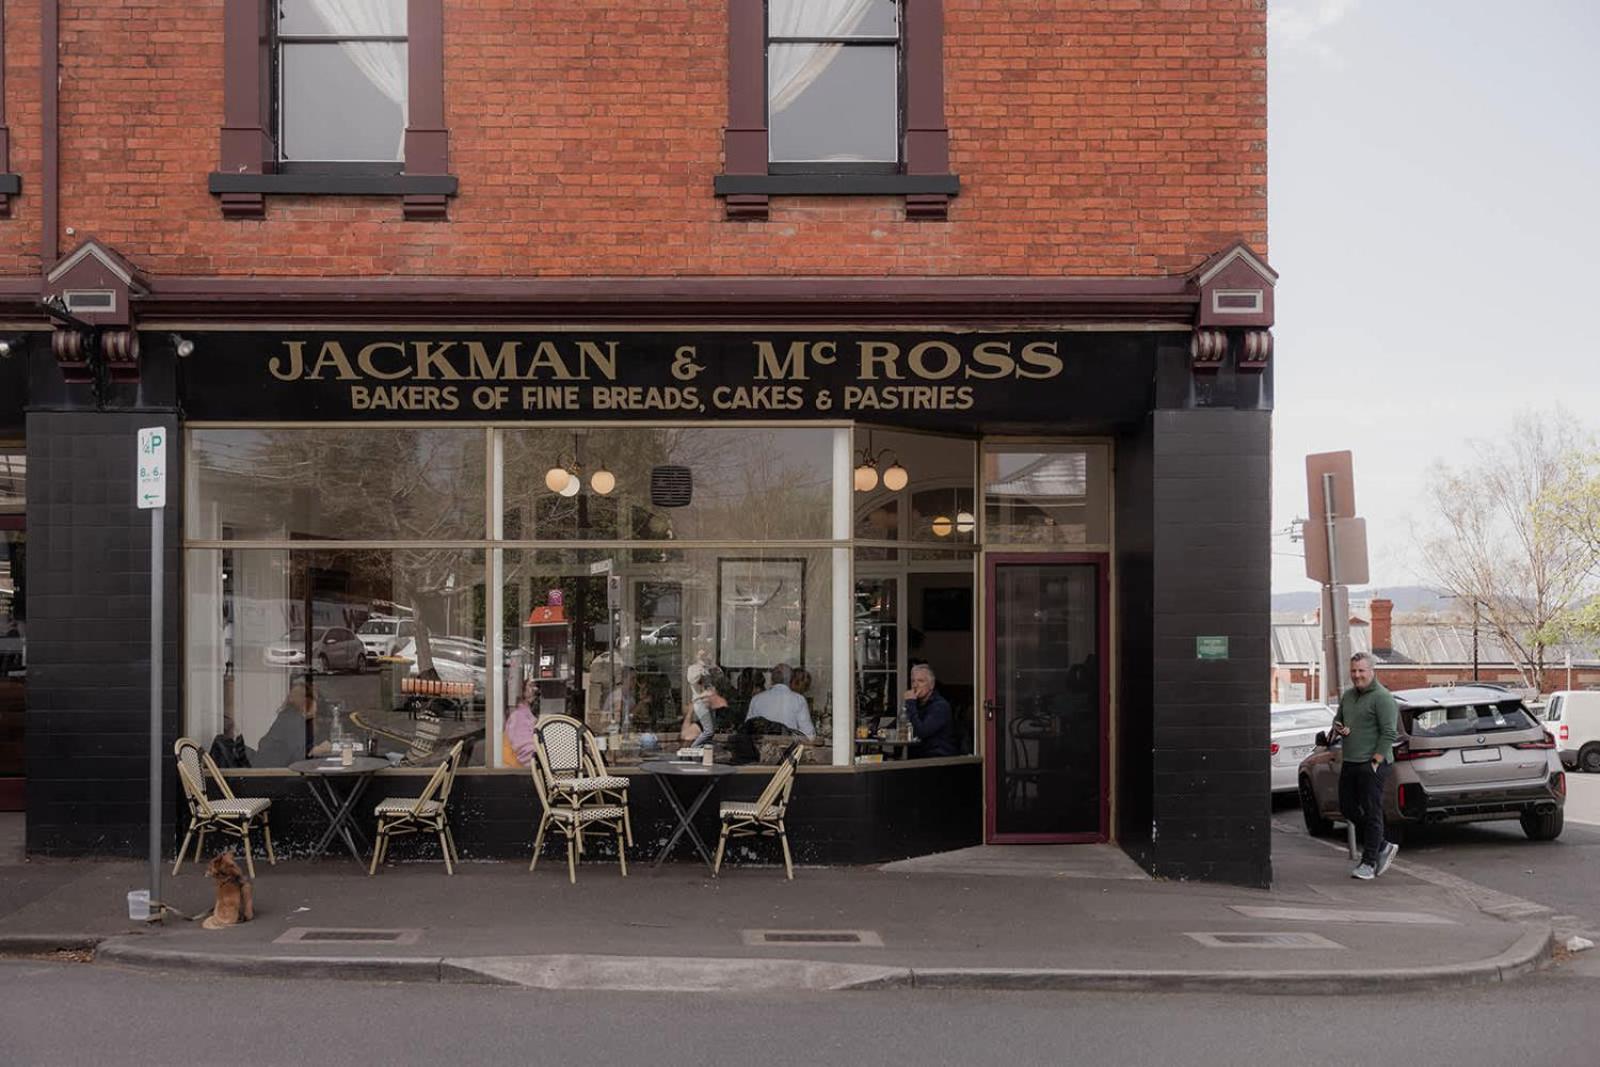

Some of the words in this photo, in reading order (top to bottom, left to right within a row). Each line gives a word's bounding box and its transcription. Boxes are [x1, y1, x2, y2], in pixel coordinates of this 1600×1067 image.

[268, 341, 620, 381] JACKMAN
[671, 346, 706, 380] &
[856, 340, 1064, 380] ROSS
[351, 386, 460, 410] BAKERS
[472, 386, 509, 410] OF
[522, 386, 580, 410] FINE
[592, 386, 705, 412] BREADS,
[712, 386, 804, 410] CAKES
[815, 389, 832, 411] &
[844, 386, 975, 410] PASTRIES
